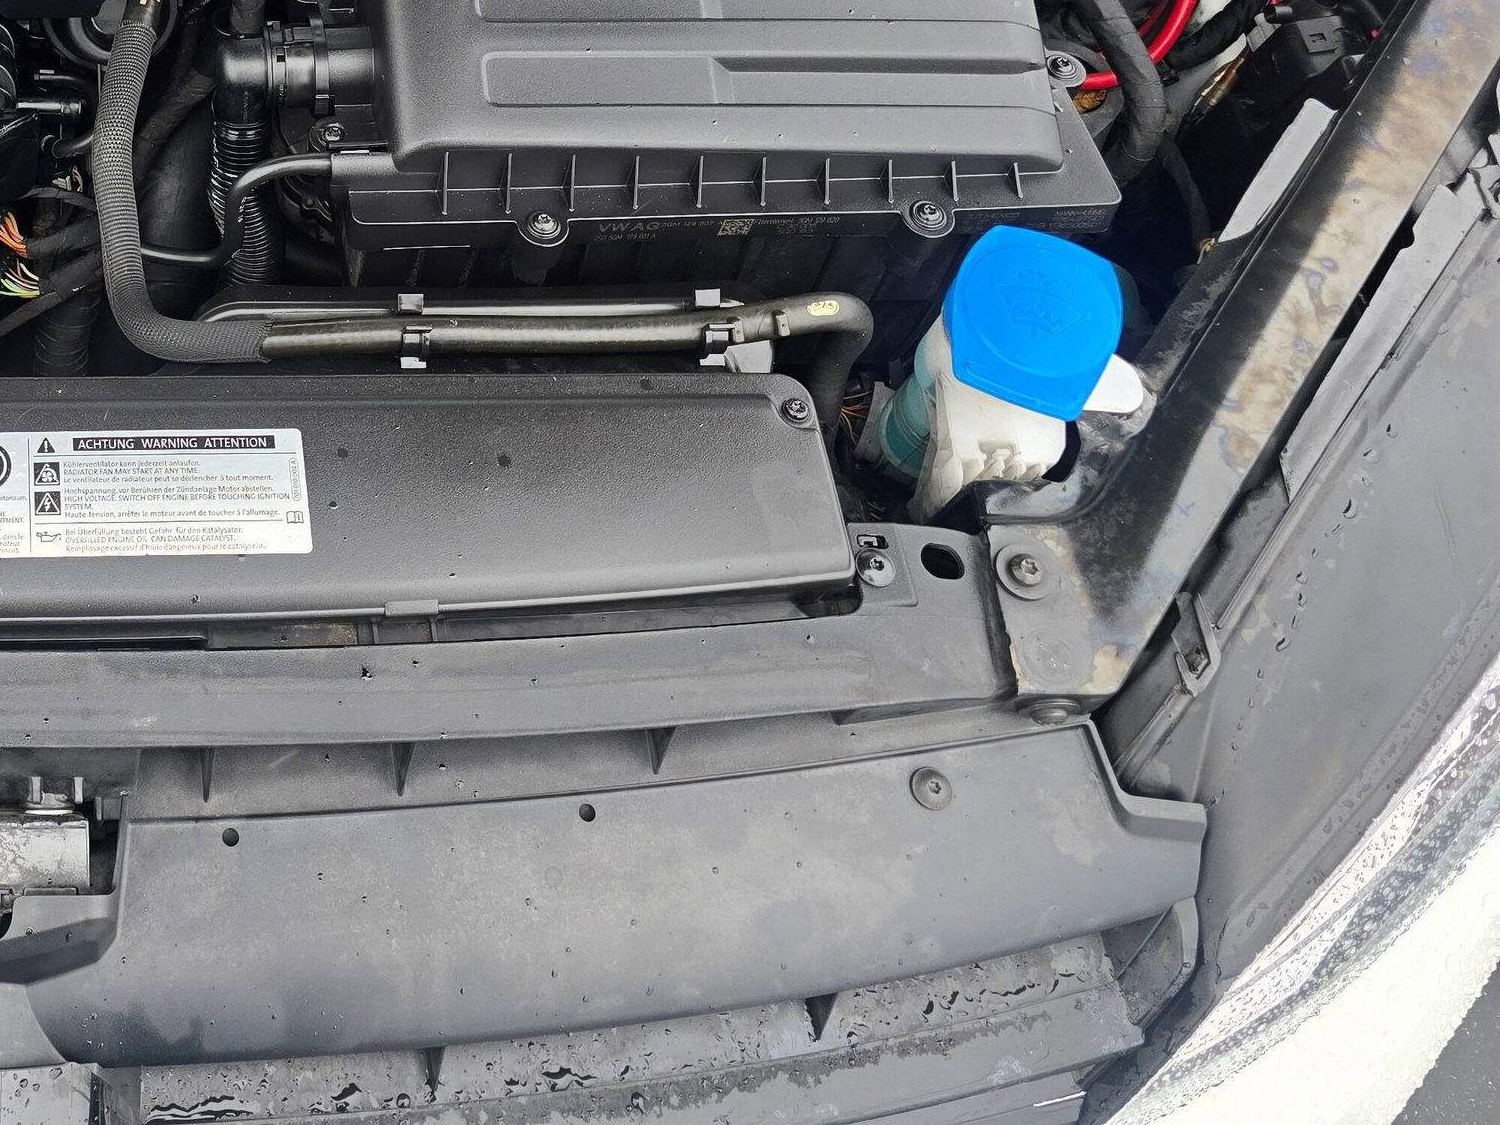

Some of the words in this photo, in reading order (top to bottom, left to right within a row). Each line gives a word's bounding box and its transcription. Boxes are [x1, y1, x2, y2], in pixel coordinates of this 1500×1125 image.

[598, 222, 630, 233] VW
[633, 221, 660, 232] AG
[77, 438, 135, 450] ACHTUNG
[141, 437, 198, 450] WARNING
[204, 436, 267, 448] ATTENTION
